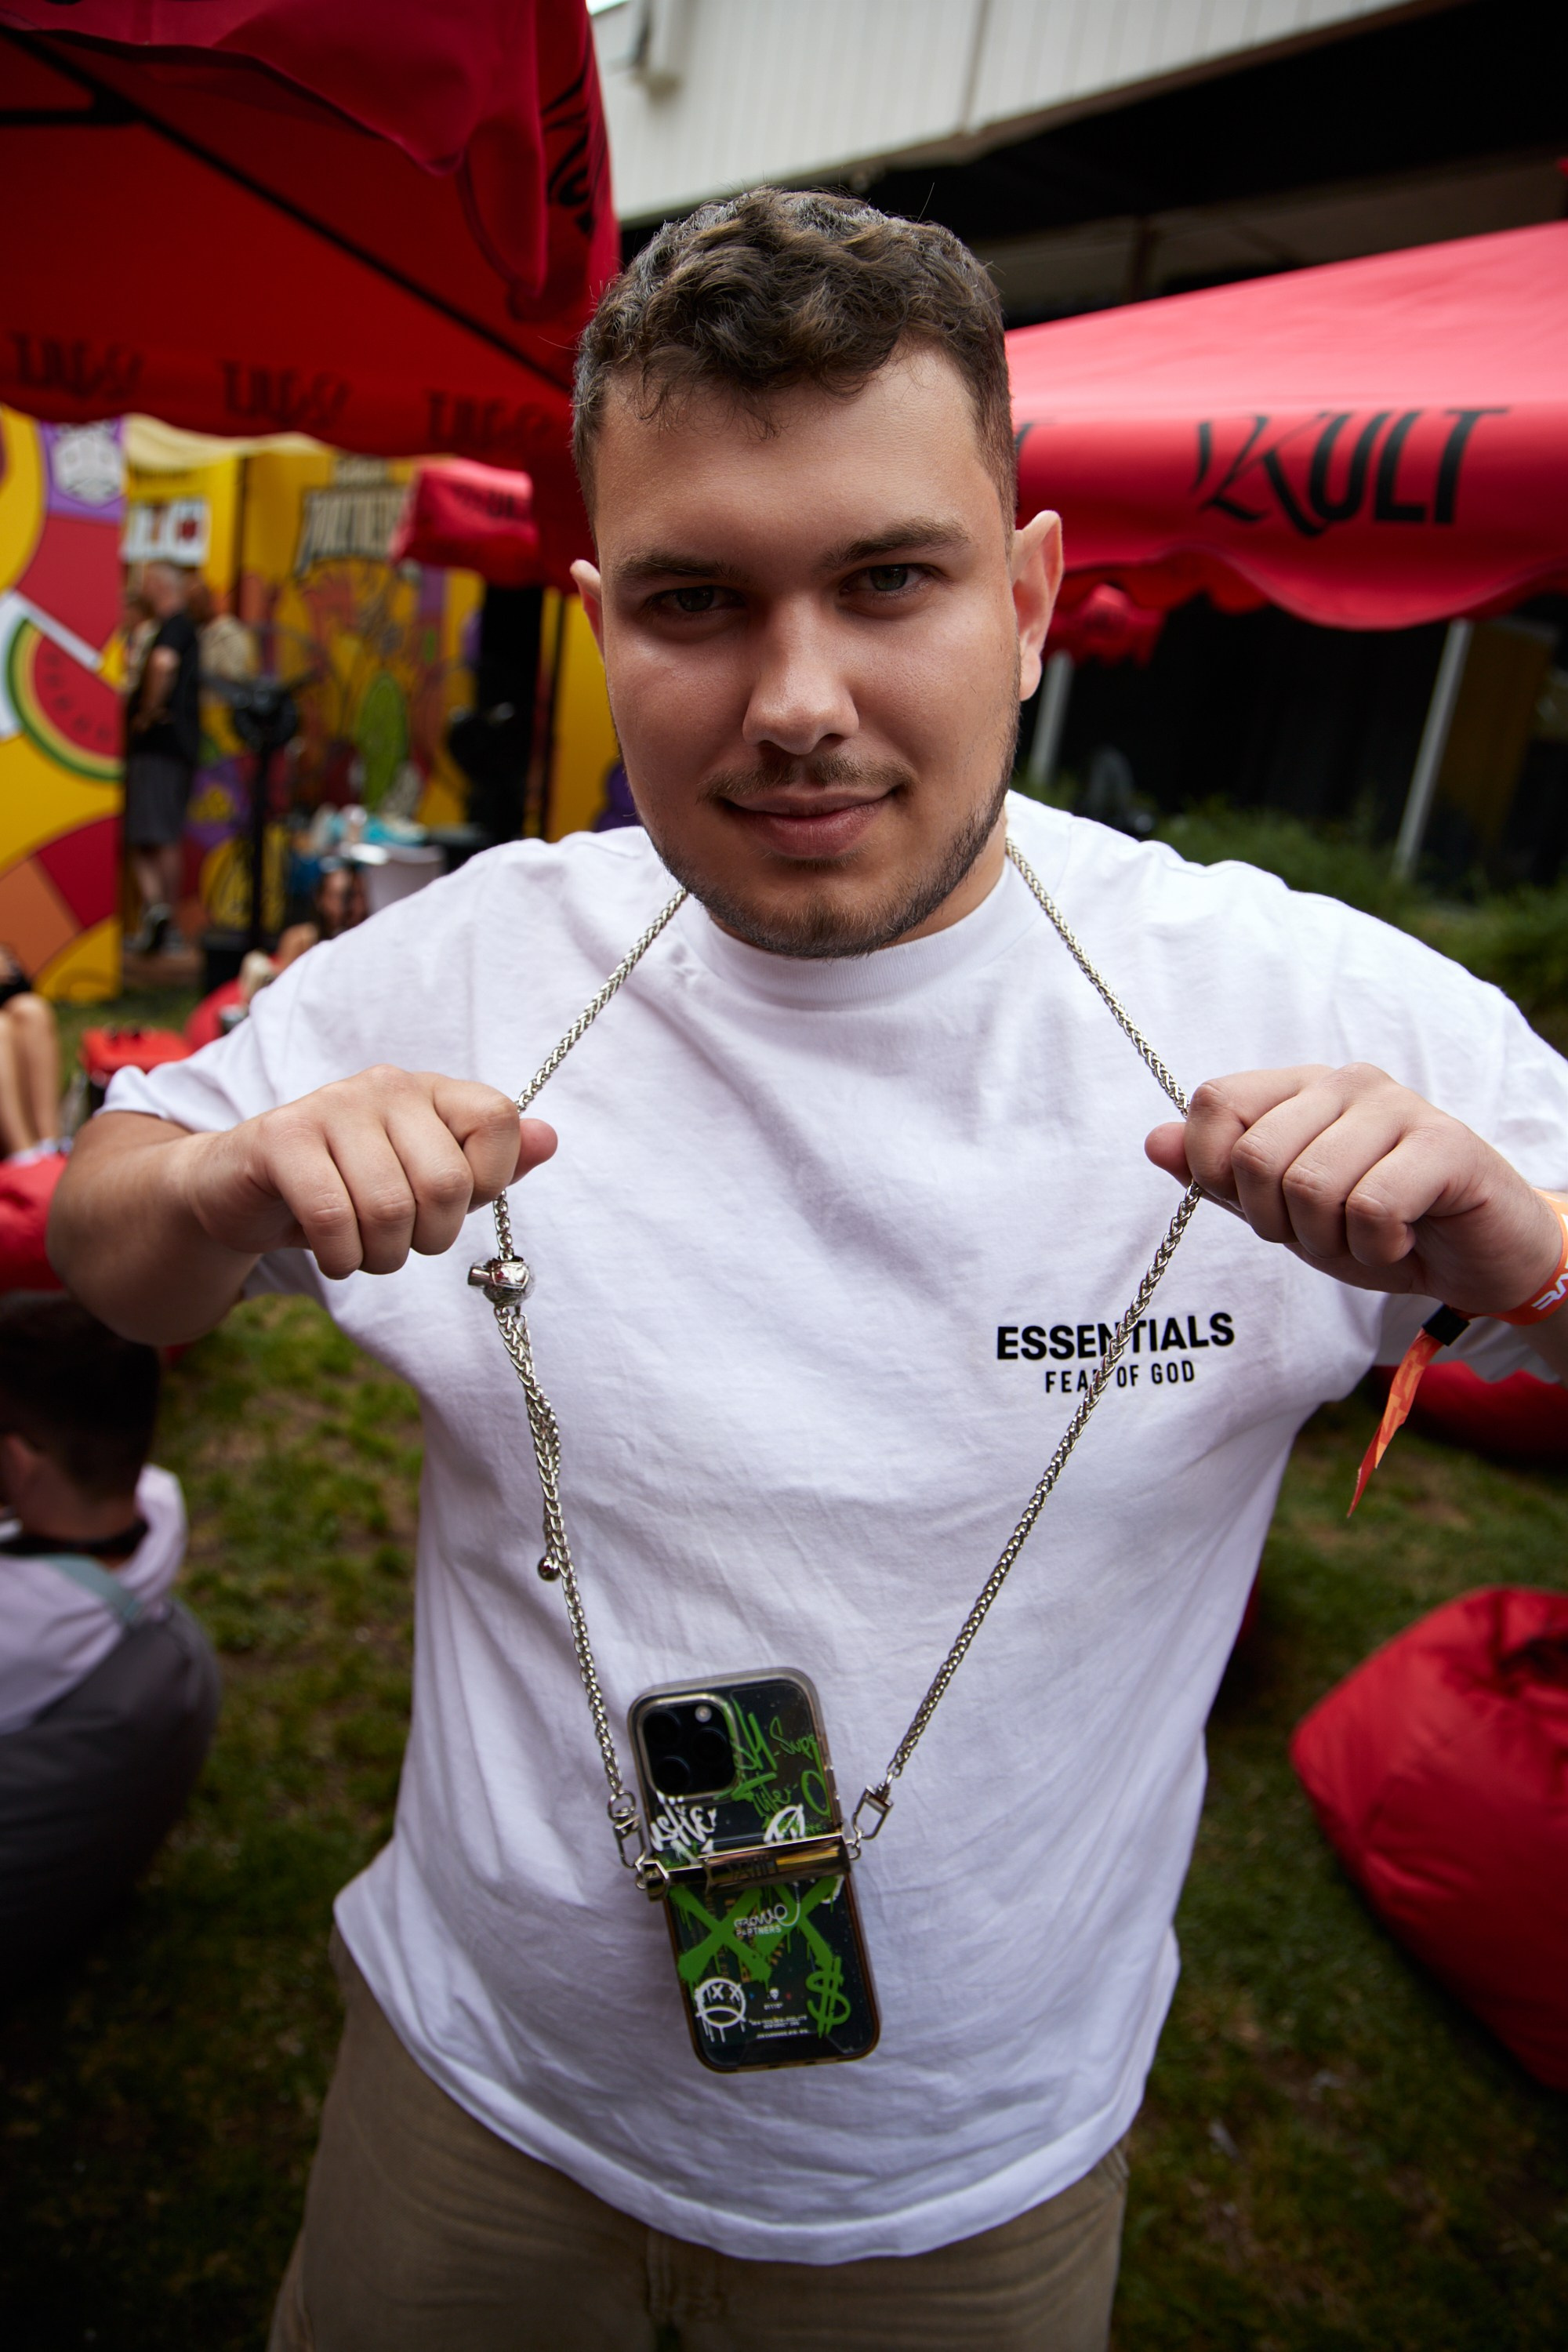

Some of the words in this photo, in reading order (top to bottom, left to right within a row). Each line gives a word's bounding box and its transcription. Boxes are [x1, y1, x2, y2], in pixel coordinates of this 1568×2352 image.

[997, 1312, 1235, 1360] ESSENTIALS
[1045, 1370, 1102, 1393] FEA
[1116, 1364, 1139, 1388] OF
[1151, 1360, 1195, 1385] GOD
